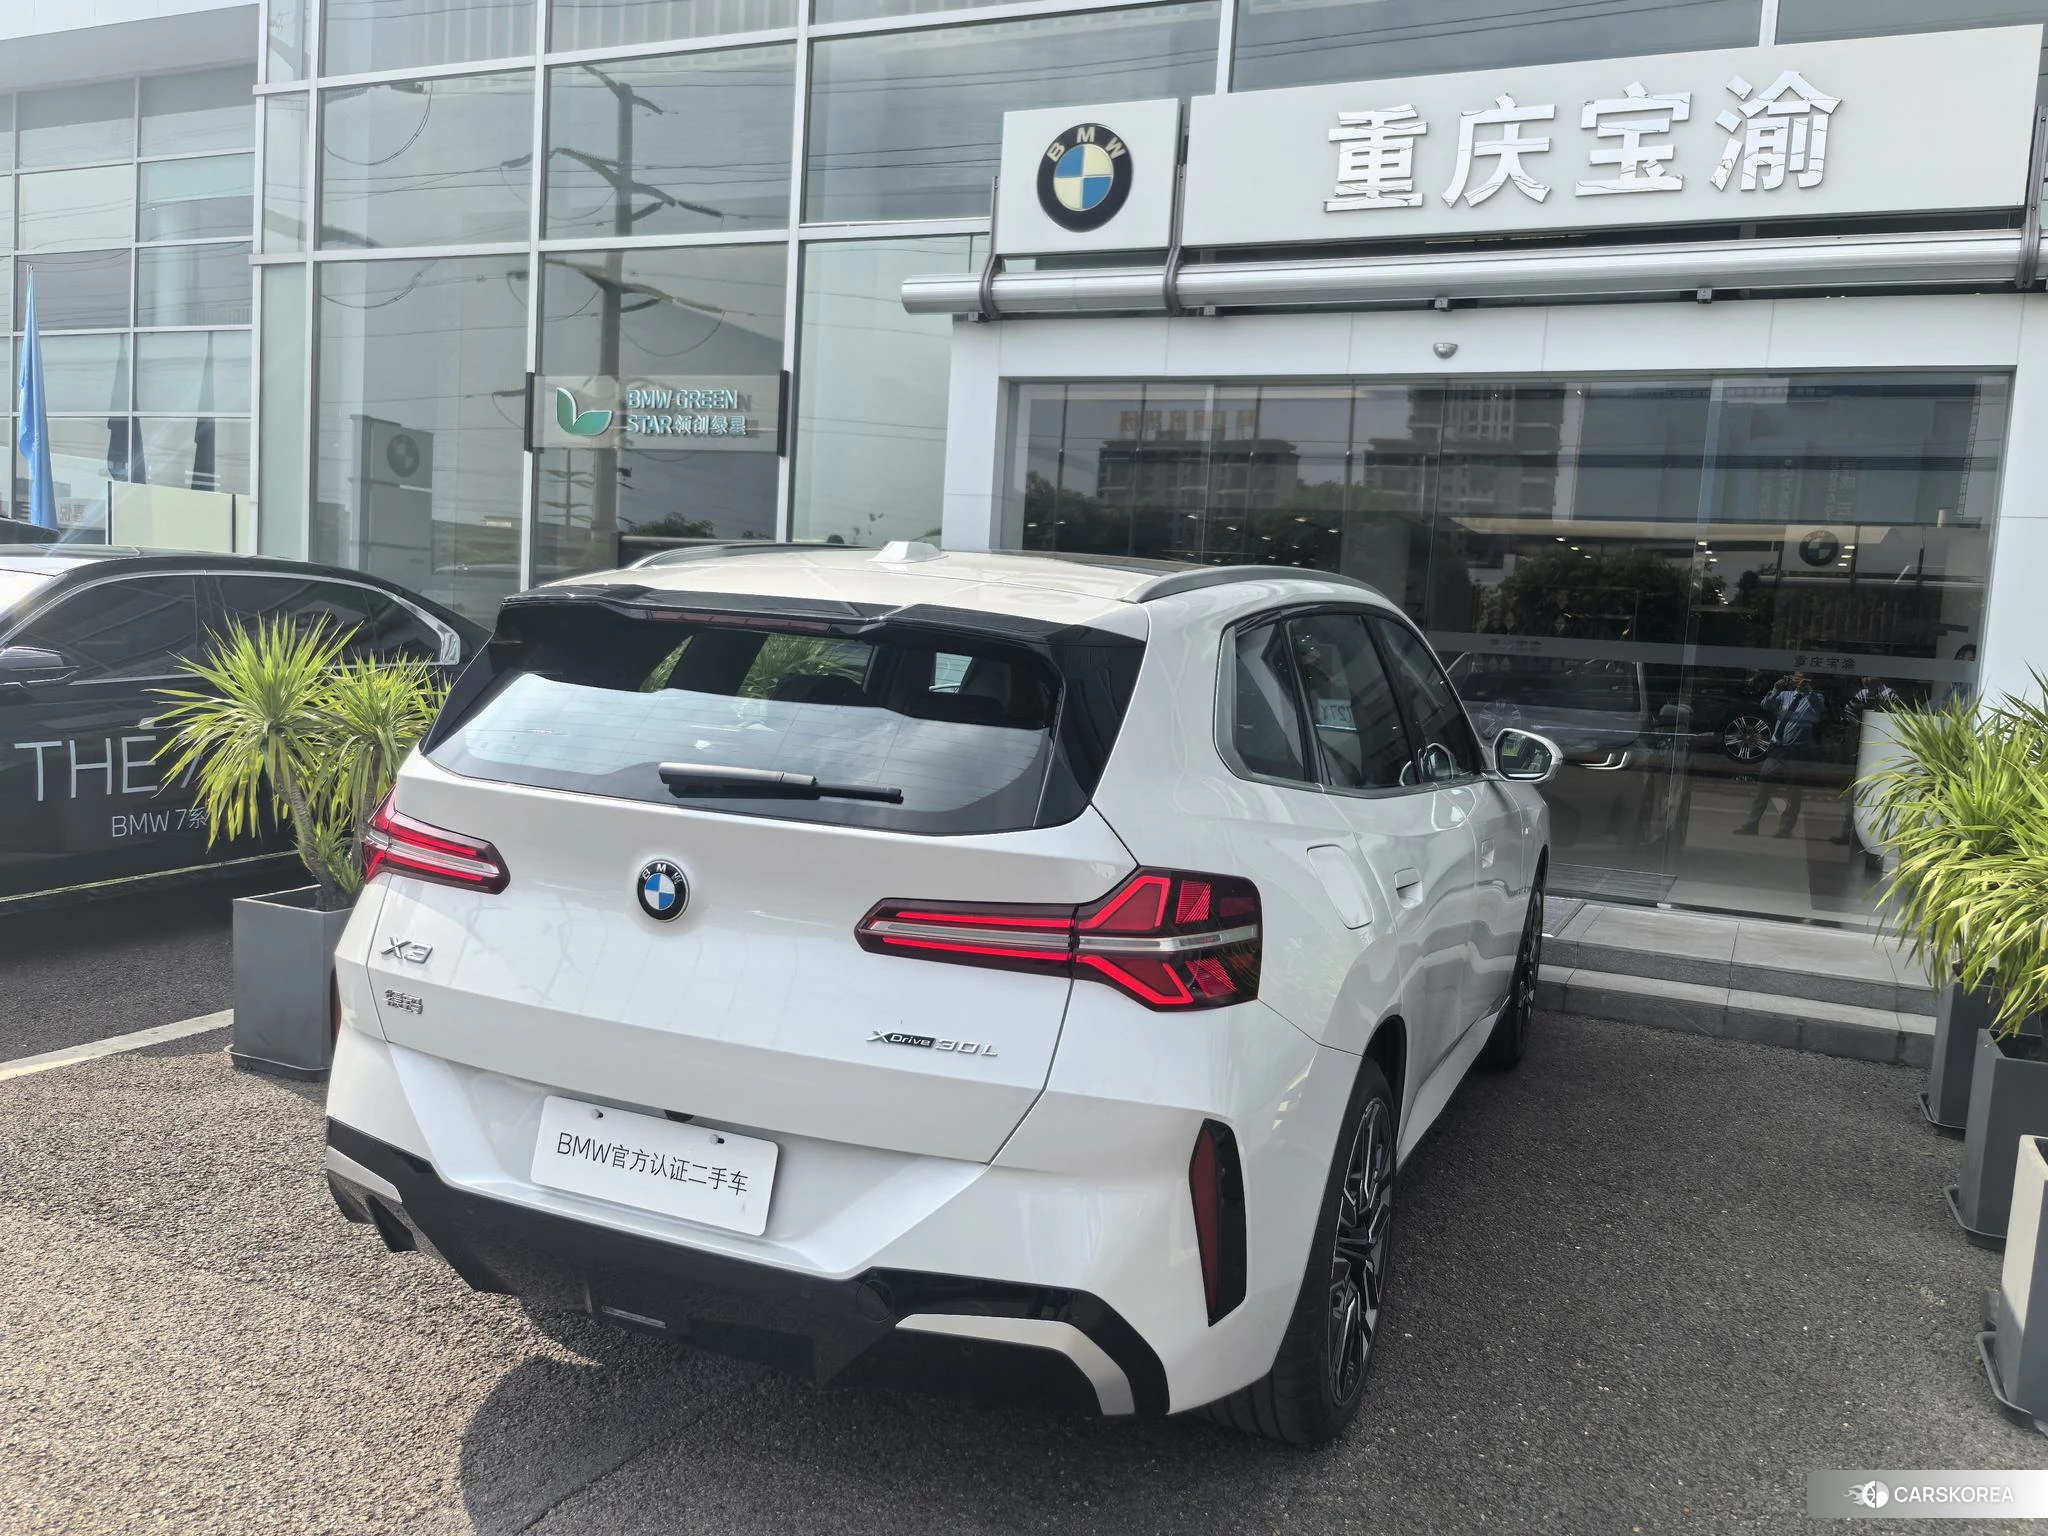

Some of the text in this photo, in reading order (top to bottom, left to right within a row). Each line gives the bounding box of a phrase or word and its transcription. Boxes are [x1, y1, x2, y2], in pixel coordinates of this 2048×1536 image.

[1046, 126, 1127, 162] BMW
[1323, 70, 1842, 213] 重庆宝渝
[626, 389, 738, 409] BMW GREEN
[626, 415, 673, 435] STAR
[14, 735, 158, 801] THE
[112, 810, 170, 838] BMW
[641, 863, 683, 885] BMW
[380, 936, 434, 965] X3
[556, 1132, 749, 1196] BMW官方认证二手车
